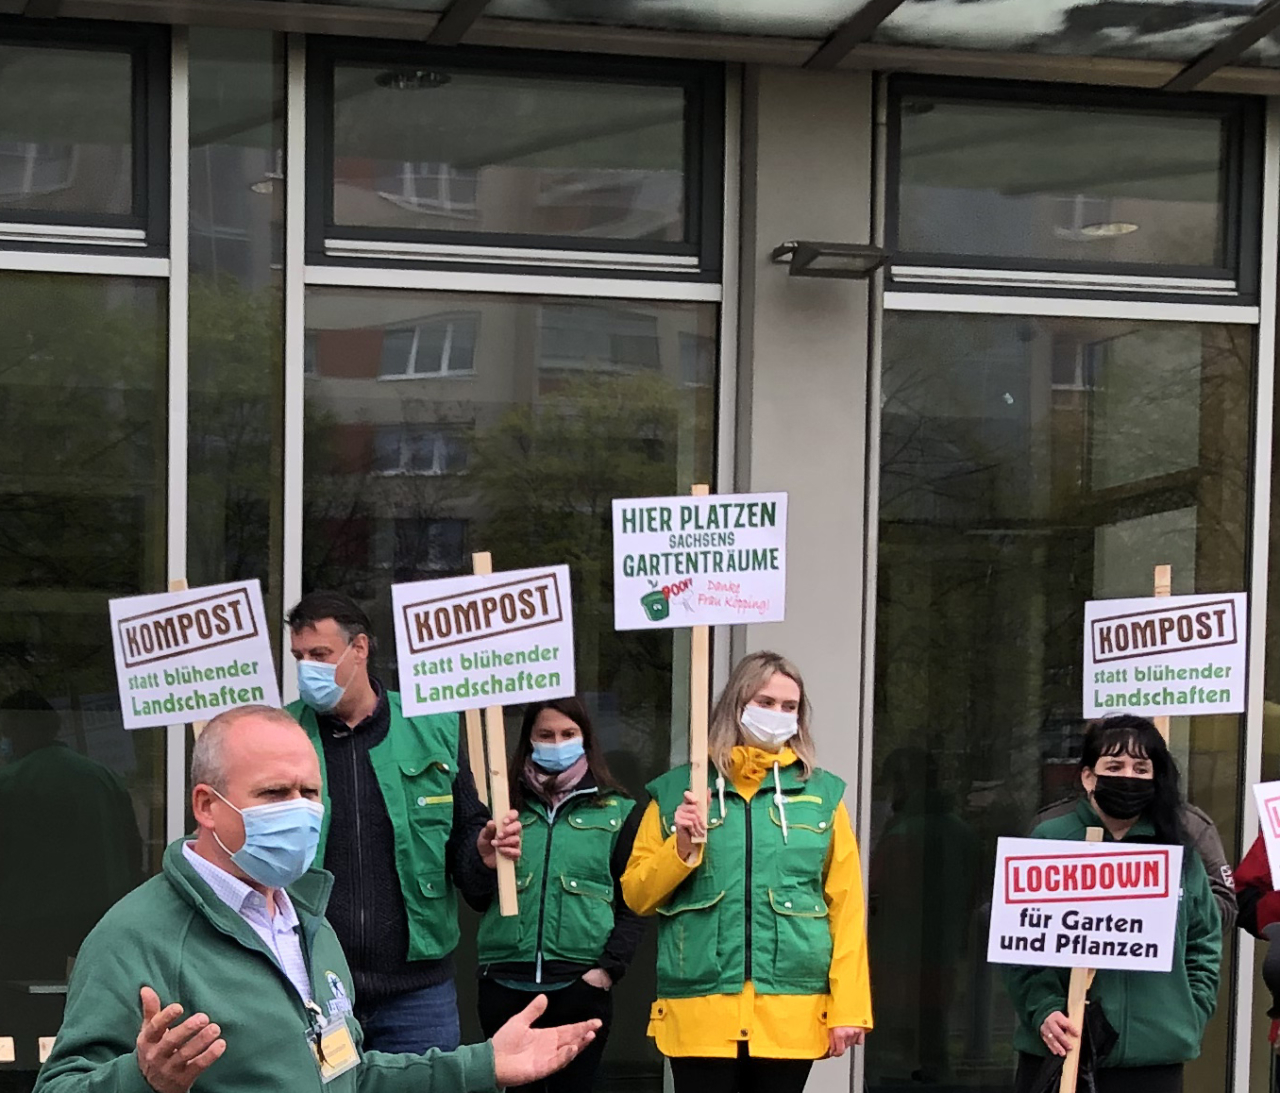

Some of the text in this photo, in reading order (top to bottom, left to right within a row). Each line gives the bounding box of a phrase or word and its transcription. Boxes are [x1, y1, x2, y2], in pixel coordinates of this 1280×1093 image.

[622, 502, 777, 533] HIER PLATZEN
[669, 531, 735, 549] SACHSENS
[623, 548, 779, 577] GARTENTRÄUME
[698, 593, 721, 606] Frau
[707, 580, 741, 594] Danke
[125, 599, 244, 658] KOMPOST
[414, 585, 550, 643] KOMPOST
[1099, 609, 1226, 655] KOMPOST
[128, 659, 258, 690] statt blühender
[413, 645, 560, 677] statt blühender
[1094, 662, 1232, 684] statt blühender
[131, 685, 265, 717] Landschaften
[415, 670, 561, 704] Landschaften
[1094, 685, 1231, 708] Landschaften
[1013, 860, 1159, 893] LOCKDOWN
[1019, 907, 1143, 934] für Garten
[1000, 932, 1159, 958] und Pflanzen
